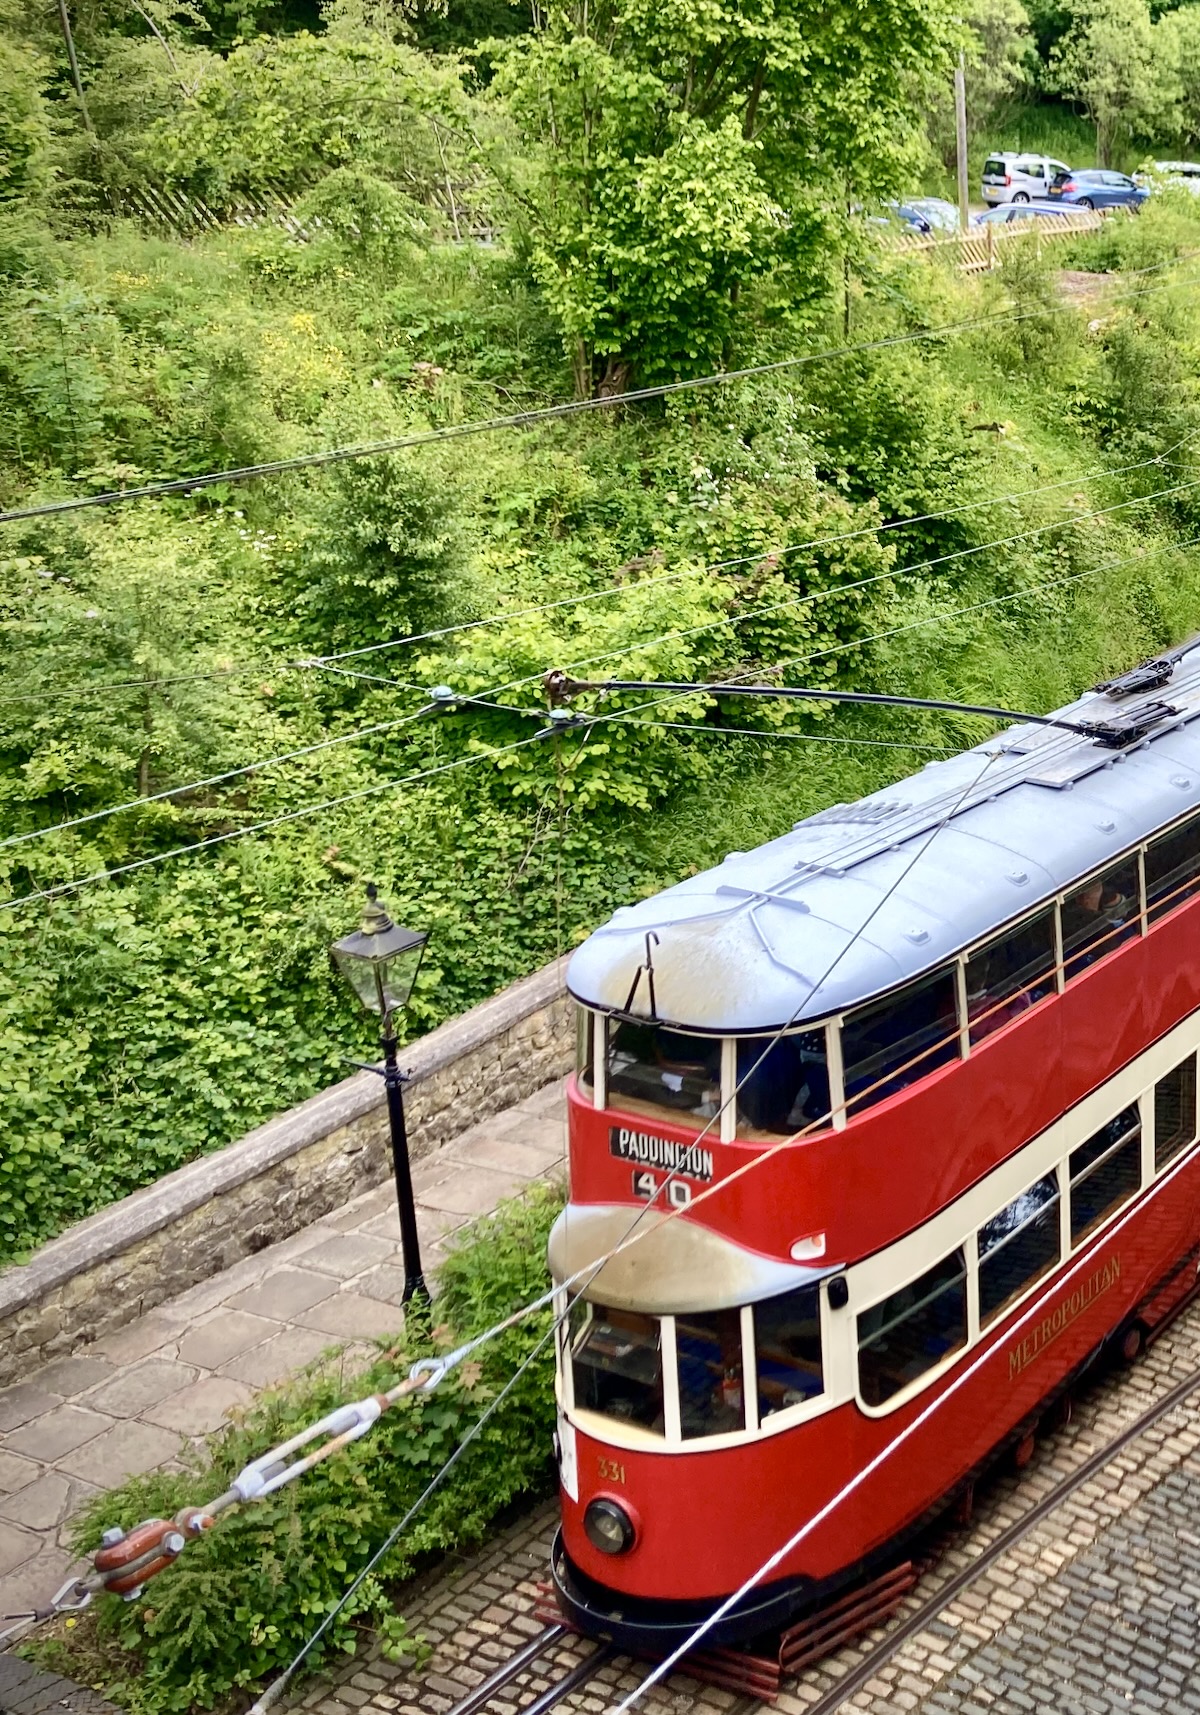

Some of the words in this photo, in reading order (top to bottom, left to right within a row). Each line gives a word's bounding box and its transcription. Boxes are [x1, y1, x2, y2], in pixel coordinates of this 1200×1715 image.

[619, 1128, 713, 1176] PADDINGTON
[637, 1173, 692, 1208] 40
[1009, 1252, 1121, 1381] METROPOLITAN
[598, 1456, 625, 1485] 331
